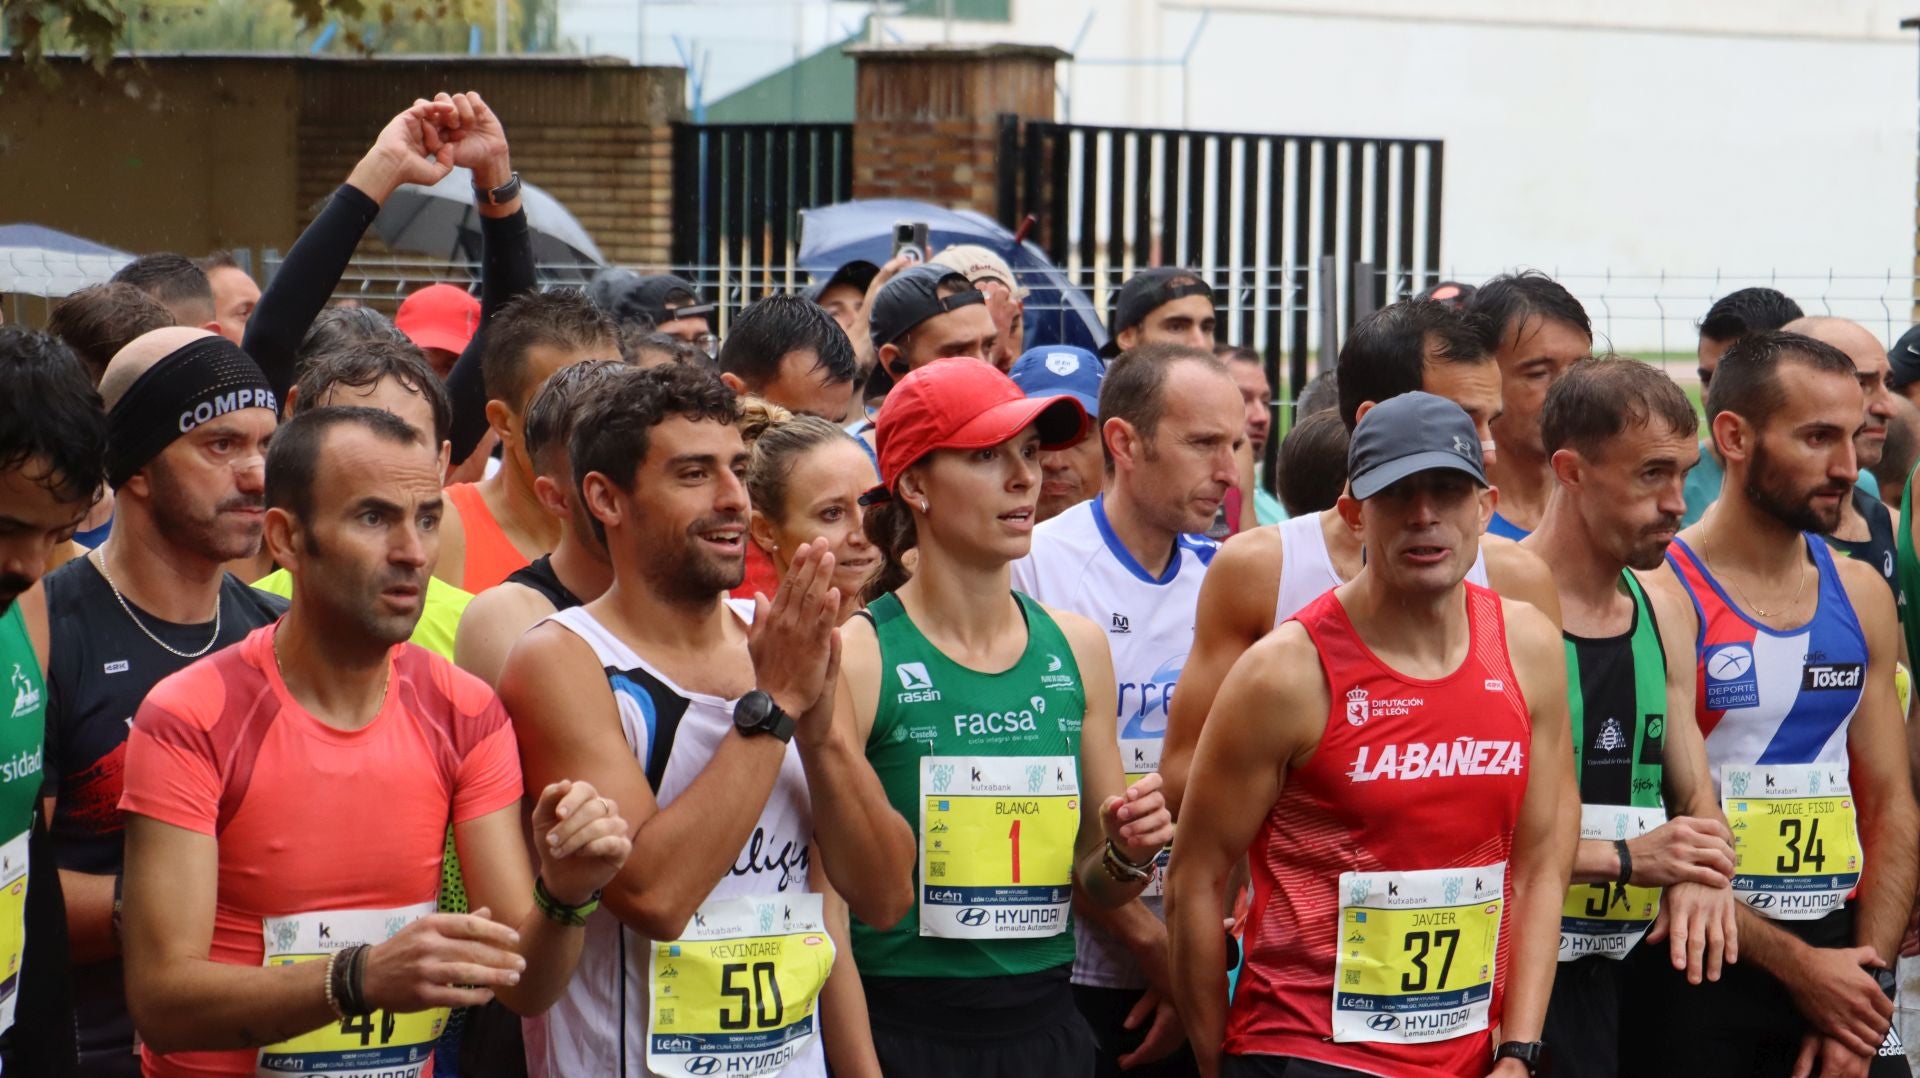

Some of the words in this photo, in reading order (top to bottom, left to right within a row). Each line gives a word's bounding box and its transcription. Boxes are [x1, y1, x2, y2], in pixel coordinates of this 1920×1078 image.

[179, 388, 279, 434] COMPRE
[1808, 667, 1860, 688] Toscaf
[897, 687, 941, 704] rasán
[1709, 684, 1756, 696] DEPORTE
[1372, 697, 1424, 708] DIPUTACIÓN
[1709, 693, 1757, 705] ASTURIANO
[1372, 708, 1384, 717] DE
[1385, 706, 1409, 716] LEÓN
[910, 729, 938, 739] Castelló
[1134, 748, 1144, 761] k
[971, 766, 981, 782] k
[1765, 774, 1775, 787] k
[971, 784, 1011, 792] kutxabank
[995, 801, 1040, 815] BLANCA
[1008, 819, 1021, 884] 1
[1776, 818, 1826, 874] 34
[1388, 881, 1399, 897] k
[1475, 877, 1483, 891] k
[1387, 896, 1428, 905] kutxabank
[1780, 893, 1840, 908] HYUNDAI
[694, 912, 706, 927] k
[783, 904, 791, 920] k
[995, 908, 1061, 924] HYUNDAI
[1412, 912, 1456, 926] JAVIER
[319, 922, 331, 939] k
[697, 925, 743, 936] kutxabank
[995, 924, 1026, 933] Lemauto
[710, 941, 782, 959] KEVINTAREK
[1572, 936, 1627, 951] HYUNDAI
[1401, 929, 1461, 992] 37
[719, 961, 784, 1030] 50
[1404, 1008, 1471, 1030] HYUNDAI
[1404, 1028, 1435, 1038] Lemauto
[727, 1046, 794, 1073] HYUNDAI
